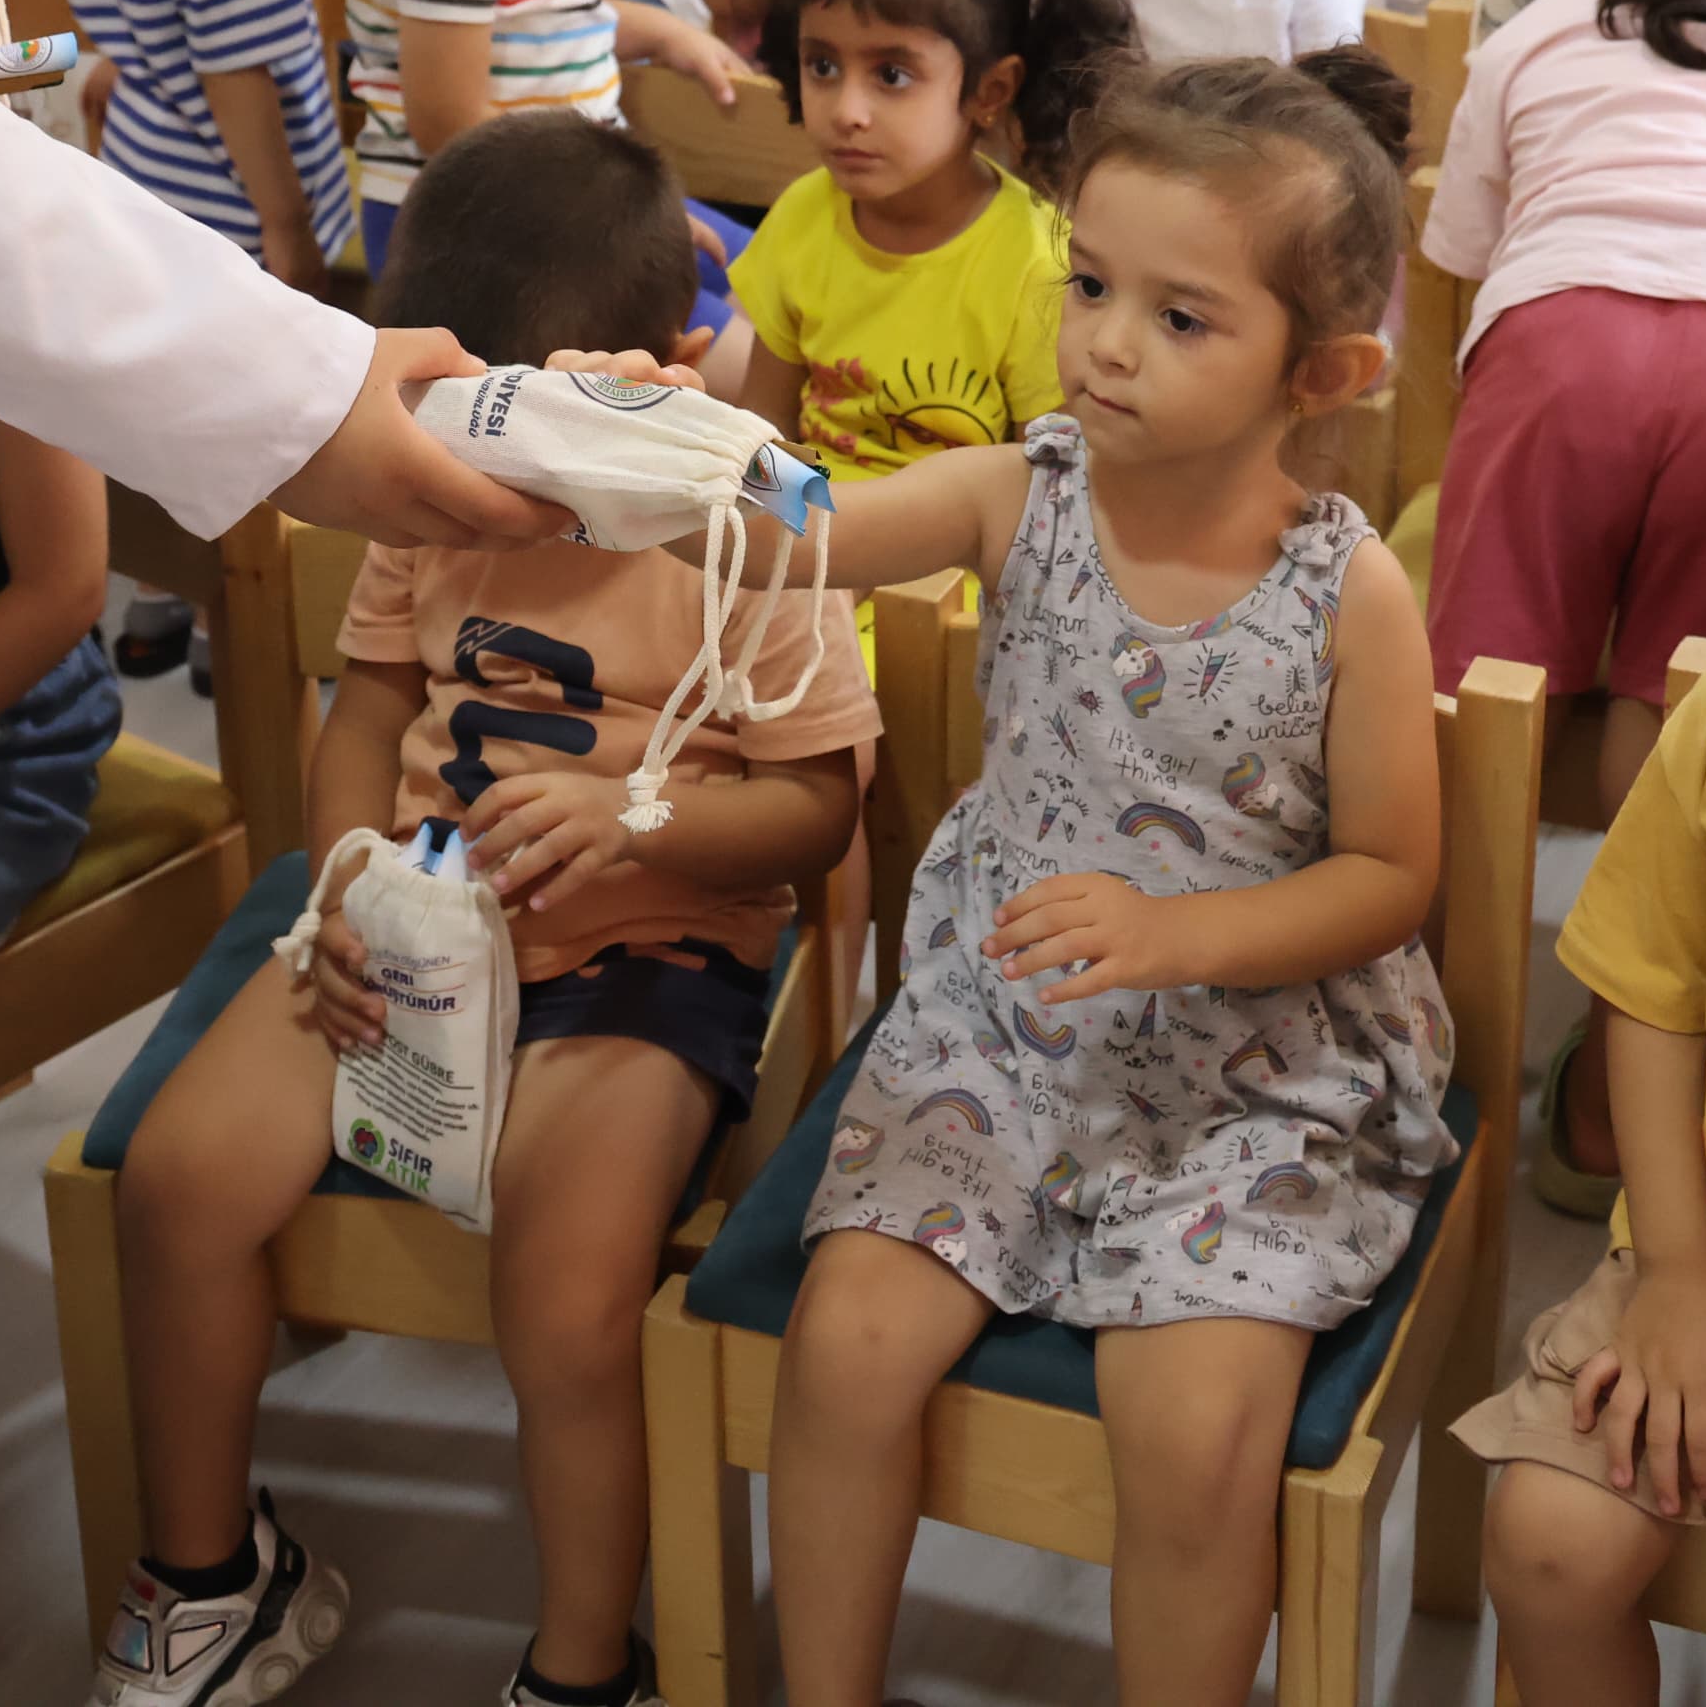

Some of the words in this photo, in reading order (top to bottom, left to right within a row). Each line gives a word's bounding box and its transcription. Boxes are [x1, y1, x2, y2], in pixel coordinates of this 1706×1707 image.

[1236, 616, 1293, 657] unicorn
[1108, 727, 1135, 753] It's
[1142, 748, 1154, 760] a
[1156, 754, 1197, 775] girl
[1114, 754, 1178, 790] thing
[411, 1051, 455, 1084] GÜBRE
[388, 1137, 433, 1176] SIFIR
[941, 1163, 955, 1176] a
[385, 1158, 431, 1194] ATIK
